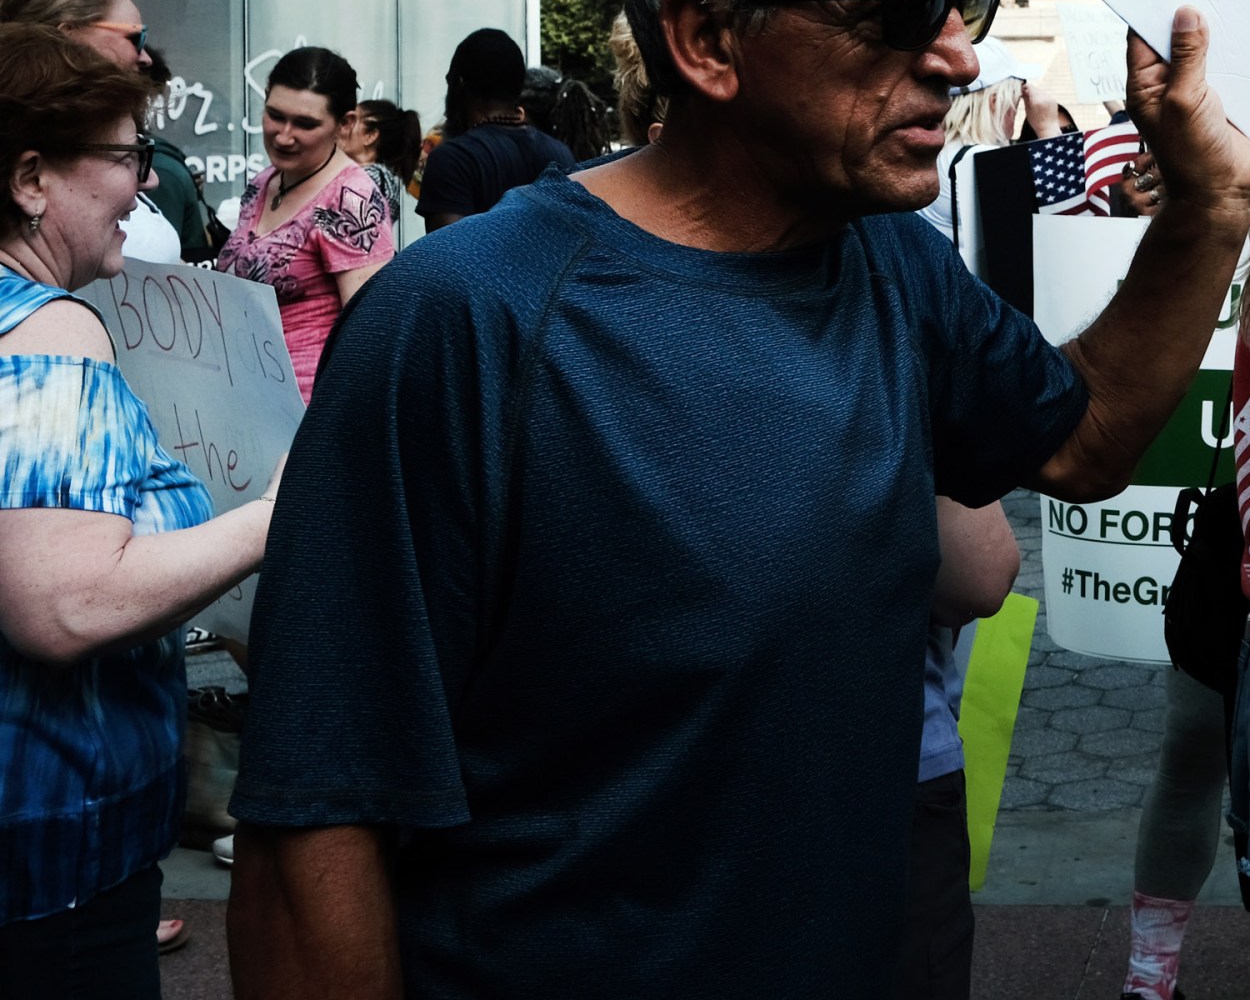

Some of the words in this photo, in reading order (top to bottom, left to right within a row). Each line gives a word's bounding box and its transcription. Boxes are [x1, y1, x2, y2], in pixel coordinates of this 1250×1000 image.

[109, 270, 234, 387] BODY
[244, 309, 286, 383] is
[173, 403, 253, 491] the
[1048, 499, 1088, 536] NO
[1100, 509, 1199, 541] FOR
